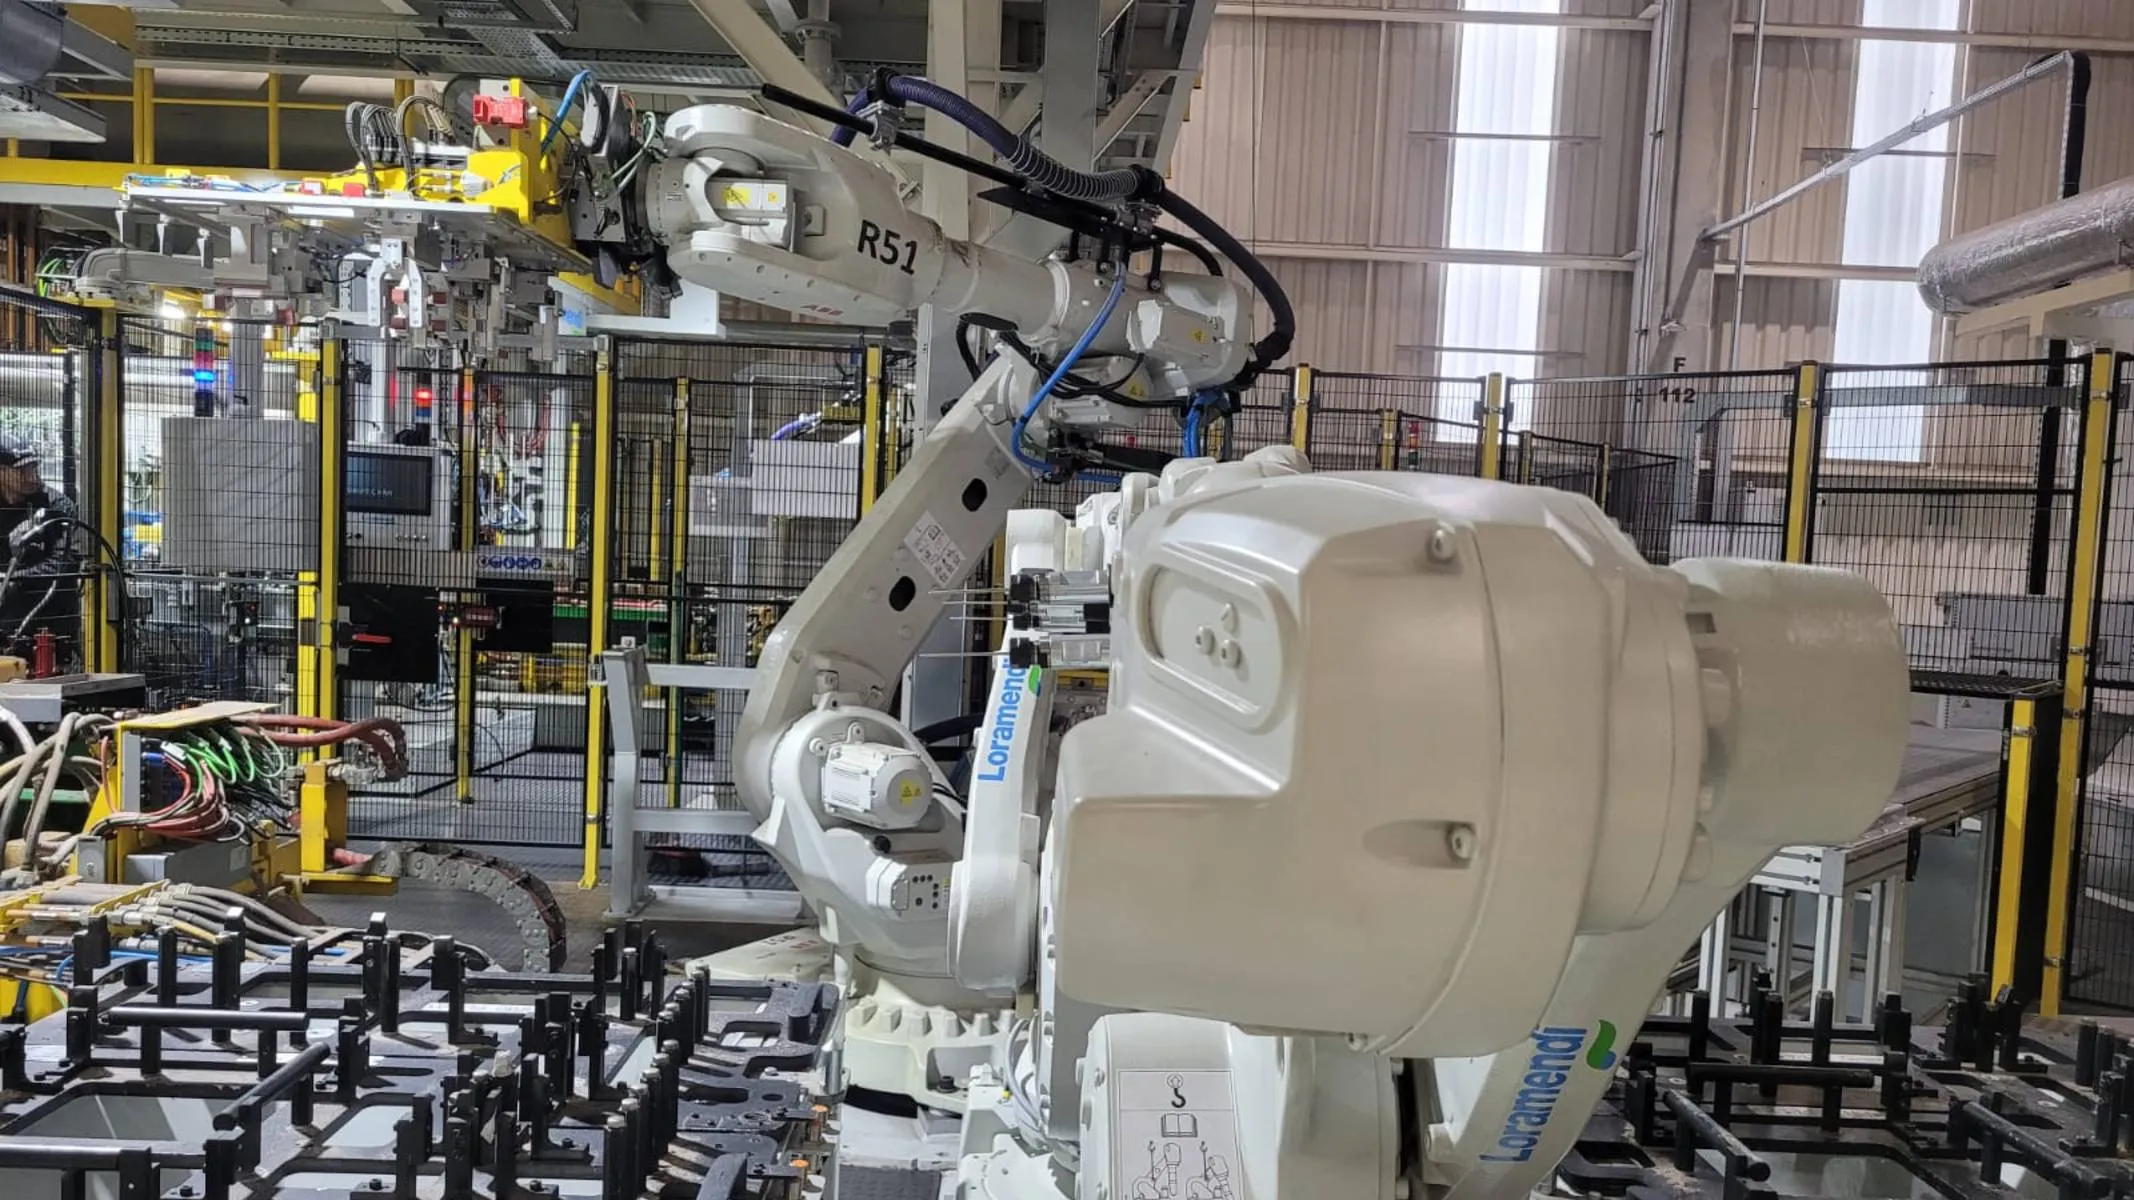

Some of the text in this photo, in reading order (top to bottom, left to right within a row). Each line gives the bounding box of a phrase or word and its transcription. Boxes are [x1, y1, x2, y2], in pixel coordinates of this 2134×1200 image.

[858, 219, 917, 274] R51
[1673, 356, 1686, 373] F
[1659, 387, 1695, 403] 112
[977, 658, 1026, 781] Loramend
[1480, 1027, 1587, 1161] Loramendi
